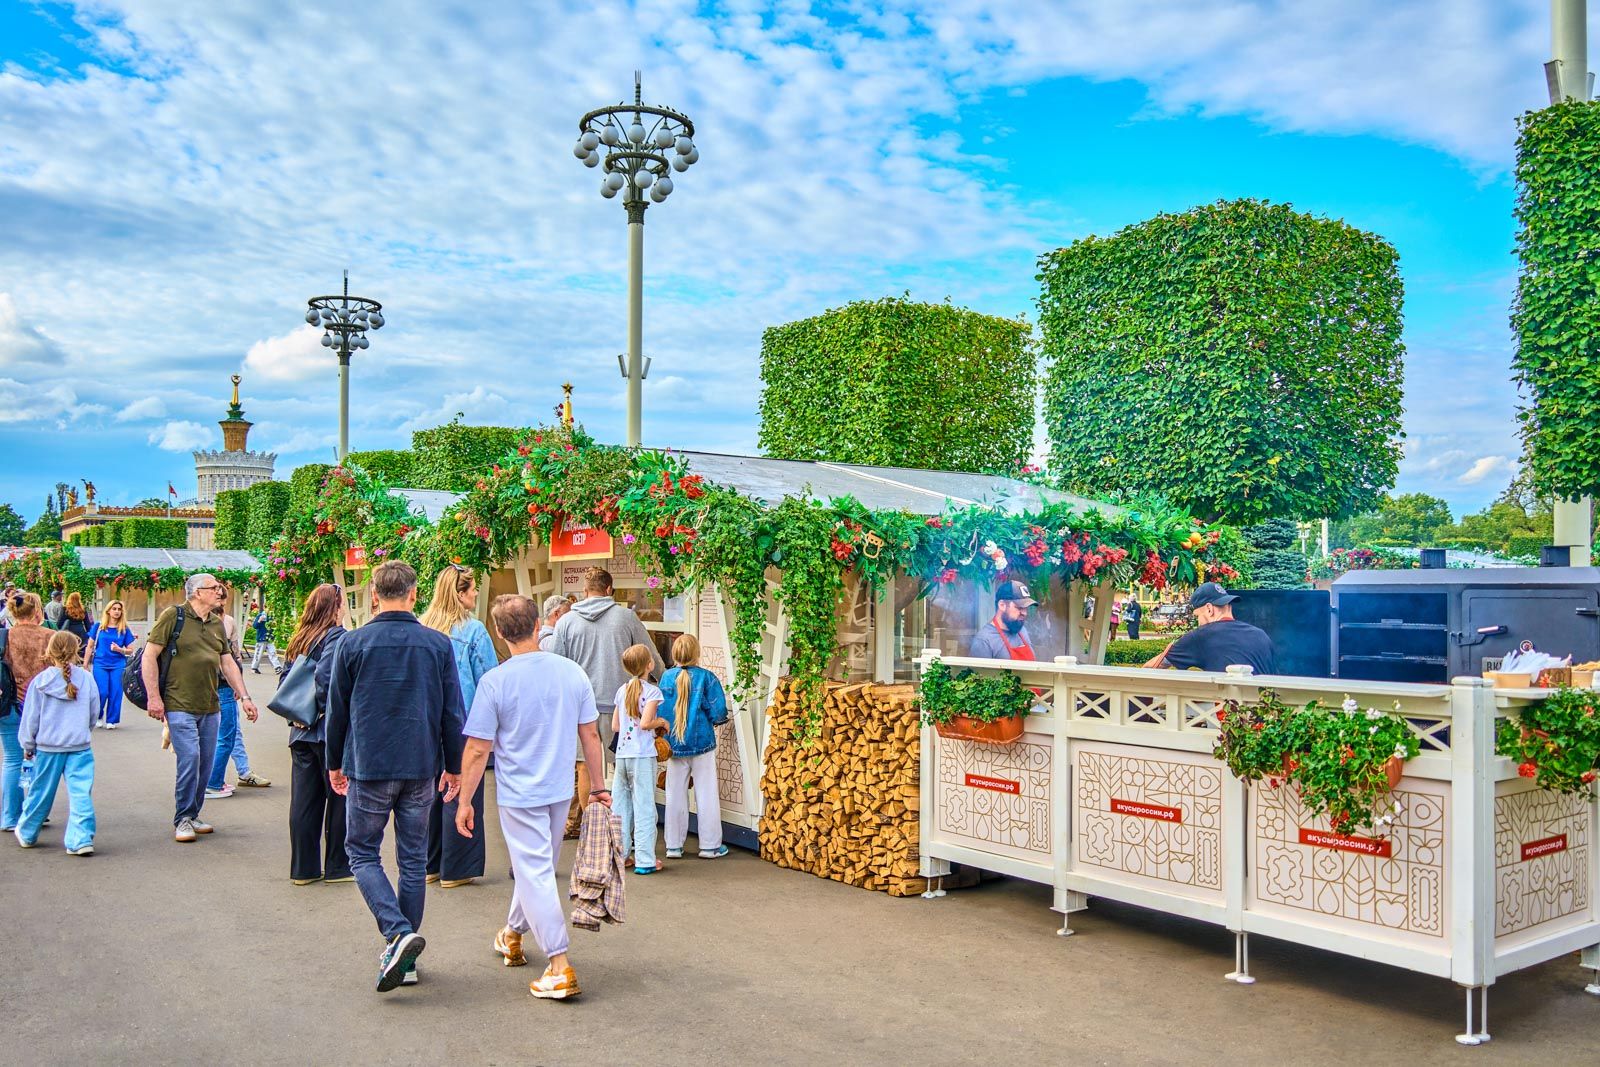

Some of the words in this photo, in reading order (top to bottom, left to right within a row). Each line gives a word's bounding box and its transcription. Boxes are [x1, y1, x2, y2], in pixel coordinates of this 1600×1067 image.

[573, 532, 586, 546] ОСЁТР
[564, 575, 579, 584] ОСЁТР
[970, 778, 1014, 791] вкусыроссии.рф
[1117, 804, 1174, 819] вкусыроссии.рф
[1525, 838, 1563, 856] вкусыроссии.рф
